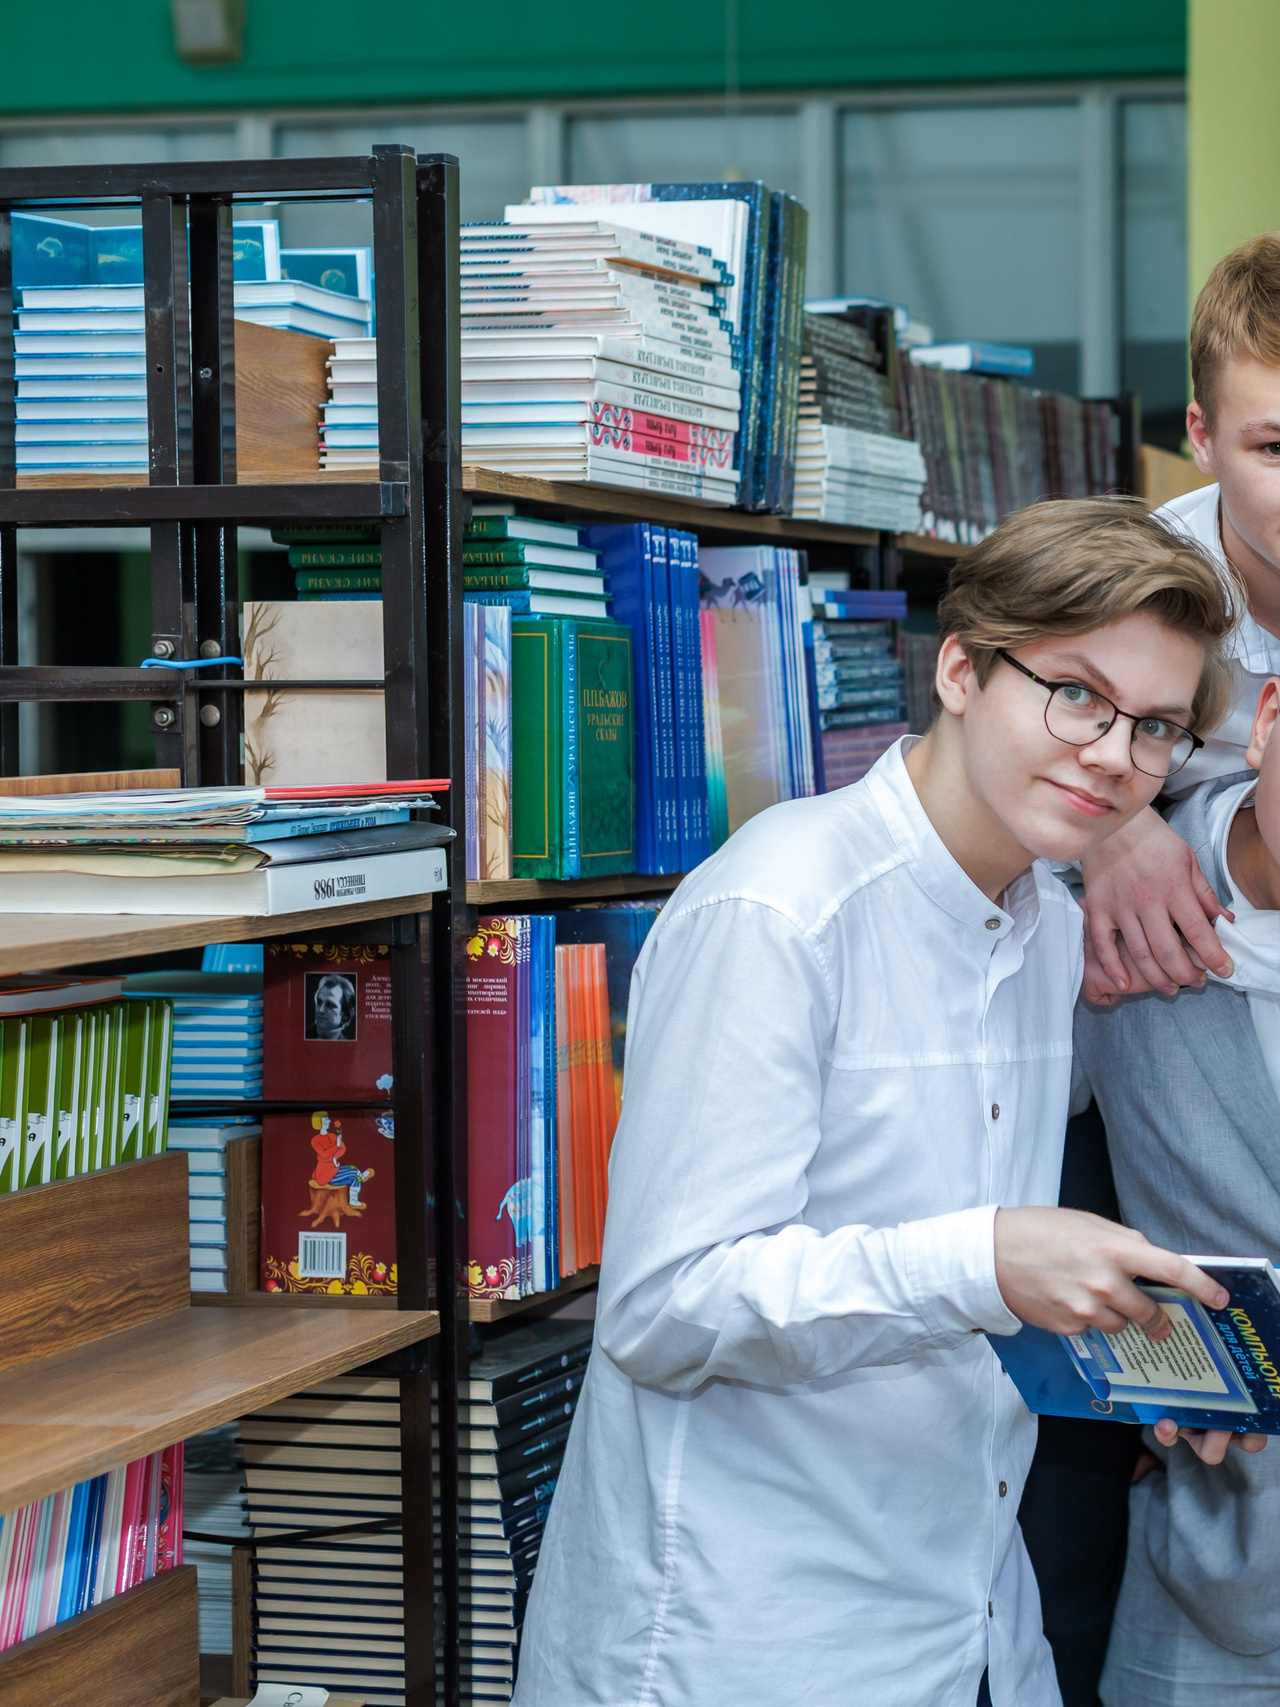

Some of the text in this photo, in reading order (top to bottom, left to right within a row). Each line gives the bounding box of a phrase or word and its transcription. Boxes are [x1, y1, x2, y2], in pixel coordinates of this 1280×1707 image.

[301, 553, 345, 564] СКАЗЫ
[308, 577, 350, 588] СКАЗЫ
[587, 713, 624, 726] УРАЛЬСКИЕ
[568, 689, 576, 770] УРАЛЬСКИЕ
[595, 728, 618, 741] СКАЗЫ
[336, 874, 366, 888] ГИННЕССА
[314, 878, 335, 900] 1988
